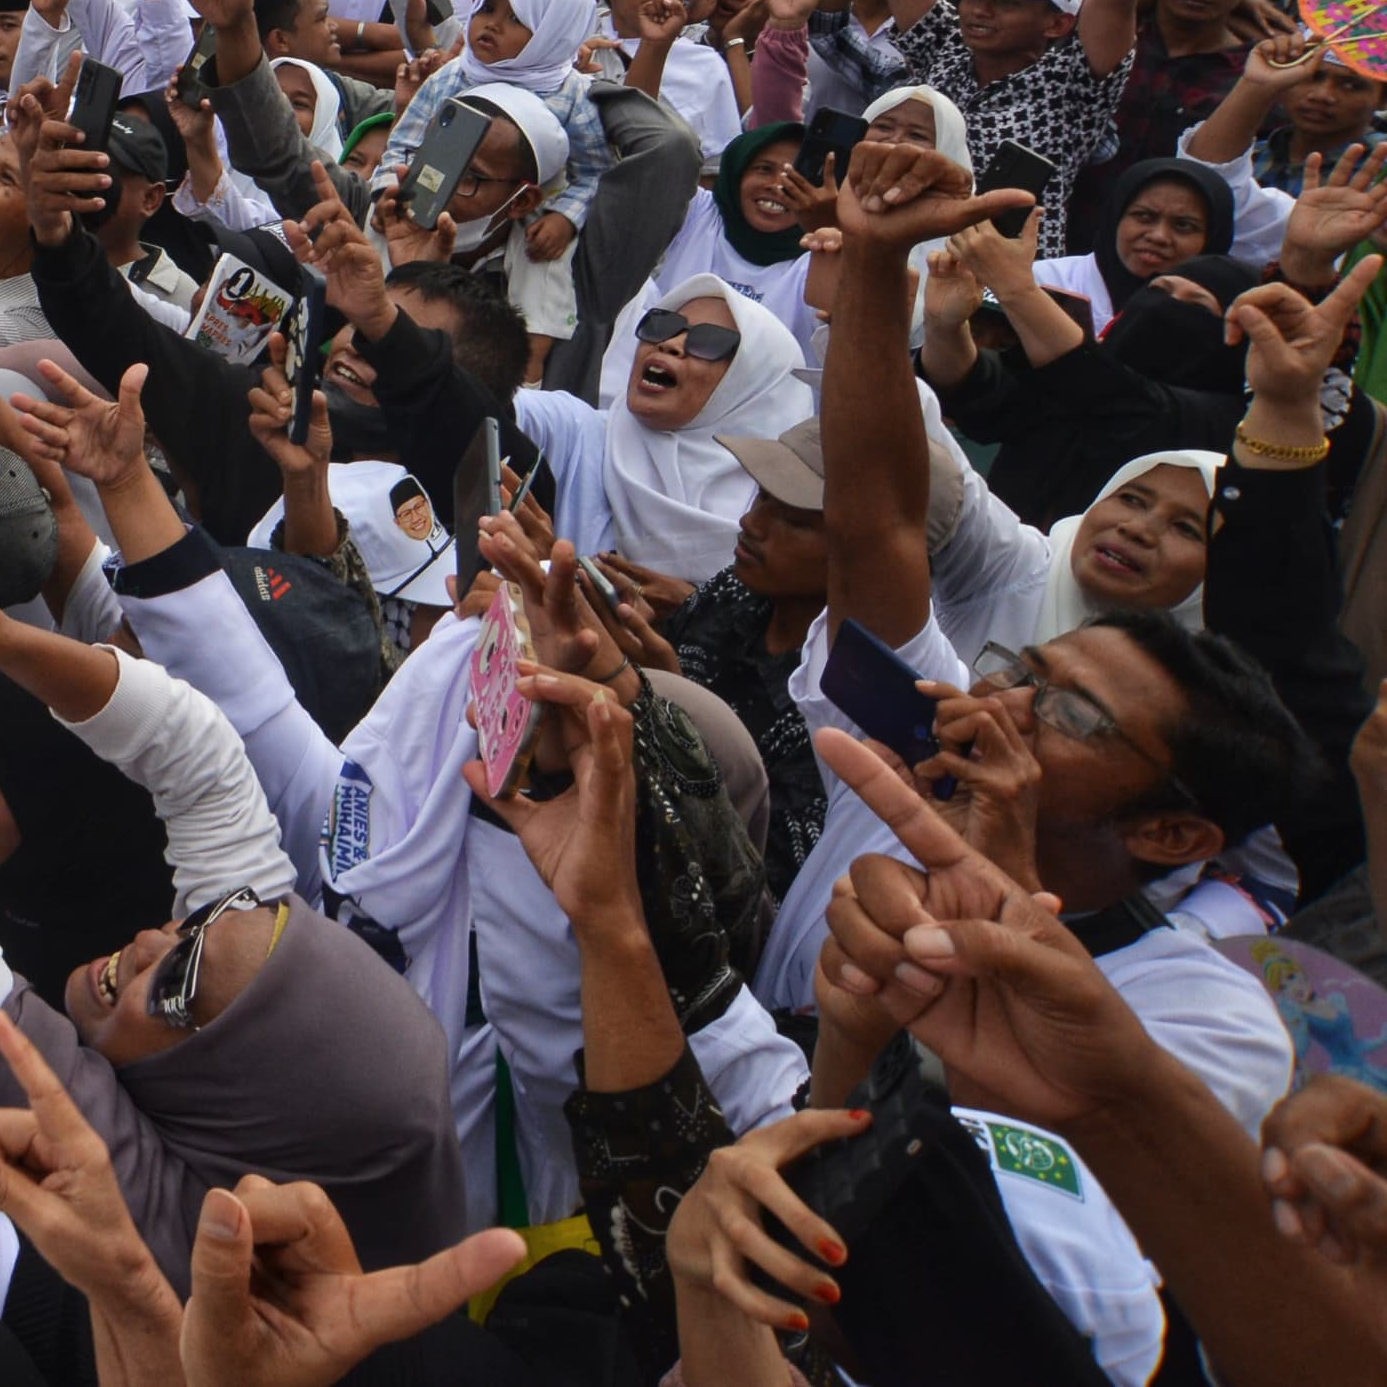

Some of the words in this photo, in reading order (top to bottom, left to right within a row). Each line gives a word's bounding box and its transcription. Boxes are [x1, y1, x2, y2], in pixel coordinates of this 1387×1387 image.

[228, 272, 251, 296] 1
[254, 566, 271, 602] adidas
[353, 784, 369, 842] ANIES
[353, 845, 367, 860] &
